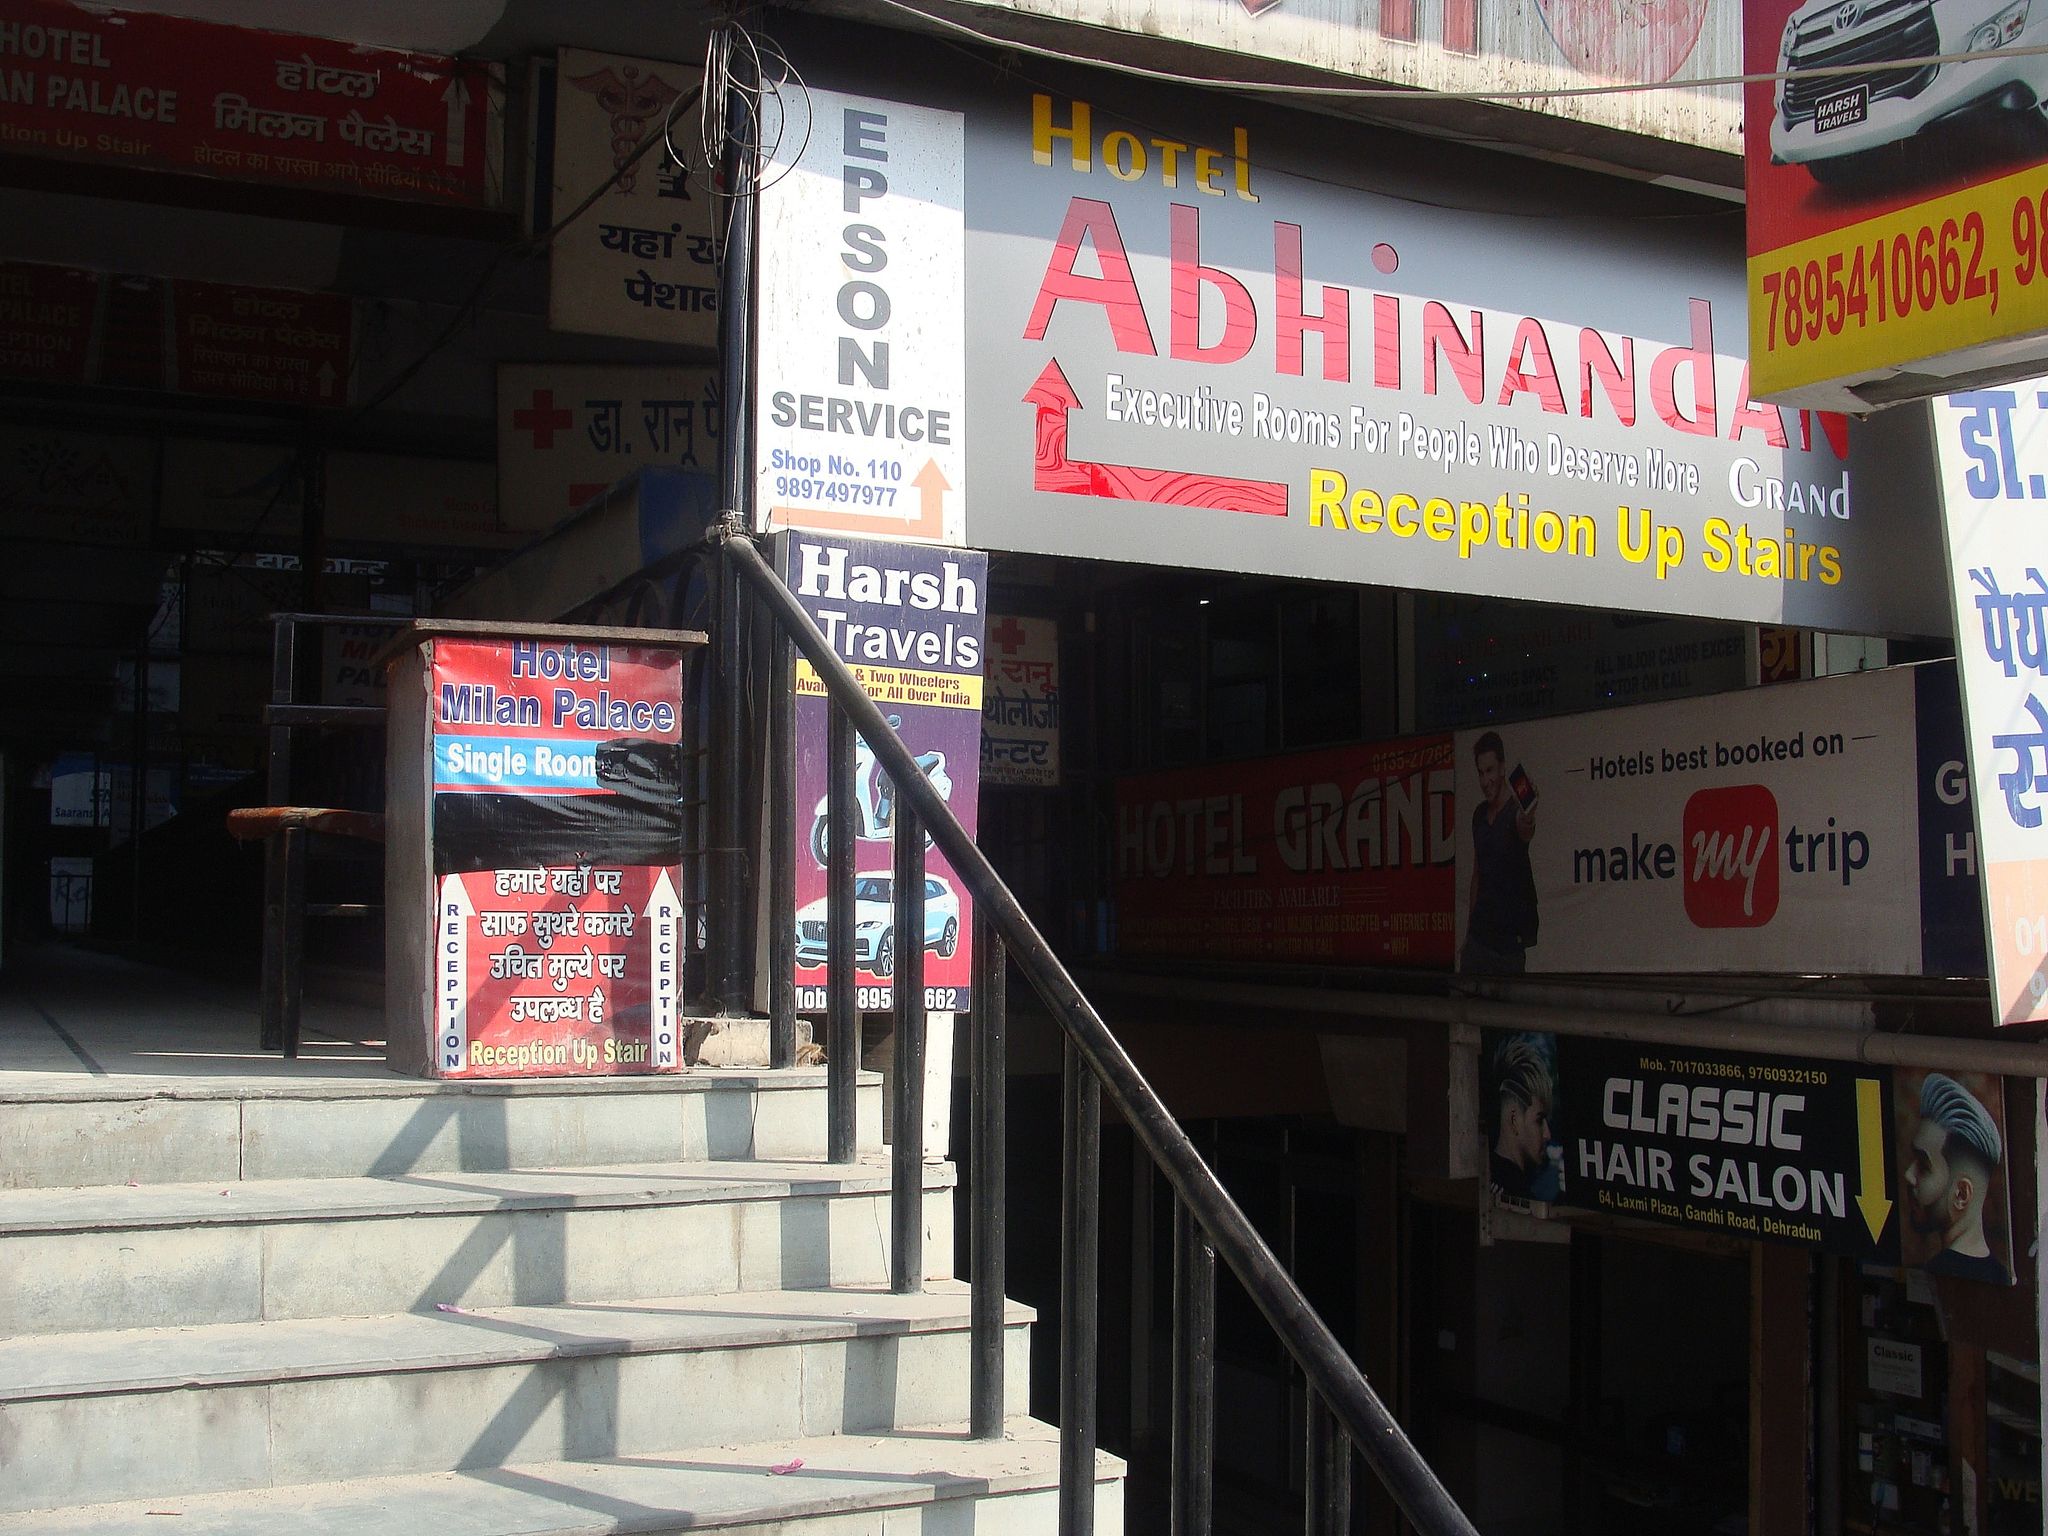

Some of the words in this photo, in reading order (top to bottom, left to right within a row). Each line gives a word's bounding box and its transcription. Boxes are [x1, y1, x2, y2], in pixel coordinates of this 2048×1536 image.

[0, 20, 111, 68] HOTEL
[274, 53, 377, 98] होटल
[47, 76, 177, 123] PALACE
[1817, 94, 1860, 119] HARSH
[1817, 108, 1862, 131] TRAVELS
[55, 129, 88, 150] Up
[97, 134, 152, 156] Stair
[212, 92, 328, 142] मिलन
[337, 109, 435, 156] पैलेस
[192, 141, 241, 167] होटल
[246, 152, 269, 171] का
[274, 156, 319, 177] रास्ता
[599, 223, 682, 260] यहां
[836, 108, 891, 390] EPSON
[1762, 211, 1999, 352] 7895410662,
[771, 391, 951, 446] SERVICE
[1105, 372, 1245, 437] Executive
[1252, 391, 1342, 449] Rooms
[1350, 405, 1391, 454] For
[1398, 412, 1482, 473] People
[1488, 424, 1539, 473] Who
[1547, 432, 1639, 487] Deserve
[1645, 447, 1700, 495] More
[771, 448, 821, 478] Shop
[828, 454, 860, 477] No.
[867, 459, 902, 481] 110
[776, 476, 897, 507] 9897497977
[1309, 467, 1596, 559] Reception
[1617, 505, 1685, 580] Up
[1702, 516, 1843, 586] Stairs
[797, 543, 978, 615] Harsh
[817, 609, 979, 668] Travels
[1594, 655, 1614, 675] ALL
[1616, 649, 1656, 671] MAJOR
[1658, 643, 1698, 666] CARDS
[511, 641, 610, 683] Hotel
[855, 667, 866, 682] &
[869, 668, 895, 684] Two
[899, 670, 960, 690] Wheelers
[1521, 664, 1558, 686] SPACE
[1594, 676, 1639, 698] DOCTOR
[1642, 672, 1659, 692] ON
[1661, 669, 1692, 690] CALL
[441, 682, 541, 728] Milan
[552, 688, 676, 733] Palace
[886, 685, 903, 699] All
[907, 688, 937, 703] Over
[940, 690, 970, 706] India
[448, 742, 527, 782] Single
[1590, 751, 1654, 780] Hotels
[1661, 745, 1708, 773] best
[1715, 731, 1804, 767] booked
[1812, 733, 1844, 757] on
[1119, 793, 1257, 879] HOTEL
[1273, 770, 1455, 873] GRAND
[494, 866, 549, 897] हमारे
[594, 869, 622, 897] पर
[1574, 832, 1676, 883] make
[1691, 824, 1771, 917] my
[1785, 816, 1870, 886] trip
[1277, 885, 1341, 908] AVAILABLE
[479, 911, 528, 937] साफ
[531, 903, 581, 949] सुथरे
[583, 904, 636, 937] कमरे
[1390, 912, 1429, 931] INTERNET
[489, 944, 544, 980] उचित
[597, 953, 627, 980] पर
[445, 903, 460, 1067] RECEPTION
[509, 995, 585, 1023] उपलब्ध
[587, 986, 605, 1024] है
[658, 906, 672, 1063] RECEPTION
[470, 1039, 568, 1070] Reception
[572, 1040, 598, 1069] Up
[603, 1038, 649, 1065] Stair
[1640, 1057, 1666, 1072] Mob.
[1670, 1060, 1745, 1080] 7017033866,
[1748, 1065, 1828, 1085] 9760932150
[1602, 1077, 1806, 1151] CLASSIC
[1578, 1138, 1675, 1192] HAIR
[1688, 1154, 1847, 1219] SALON
[1598, 1190, 1614, 1209] 64,
[1616, 1192, 1648, 1212] Laxmi
[1650, 1199, 1683, 1221] Plaza,
[1685, 1204, 1724, 1225] Gandhi
[1727, 1211, 1760, 1235] Road,
[1763, 1217, 1822, 1242] Dehradun
